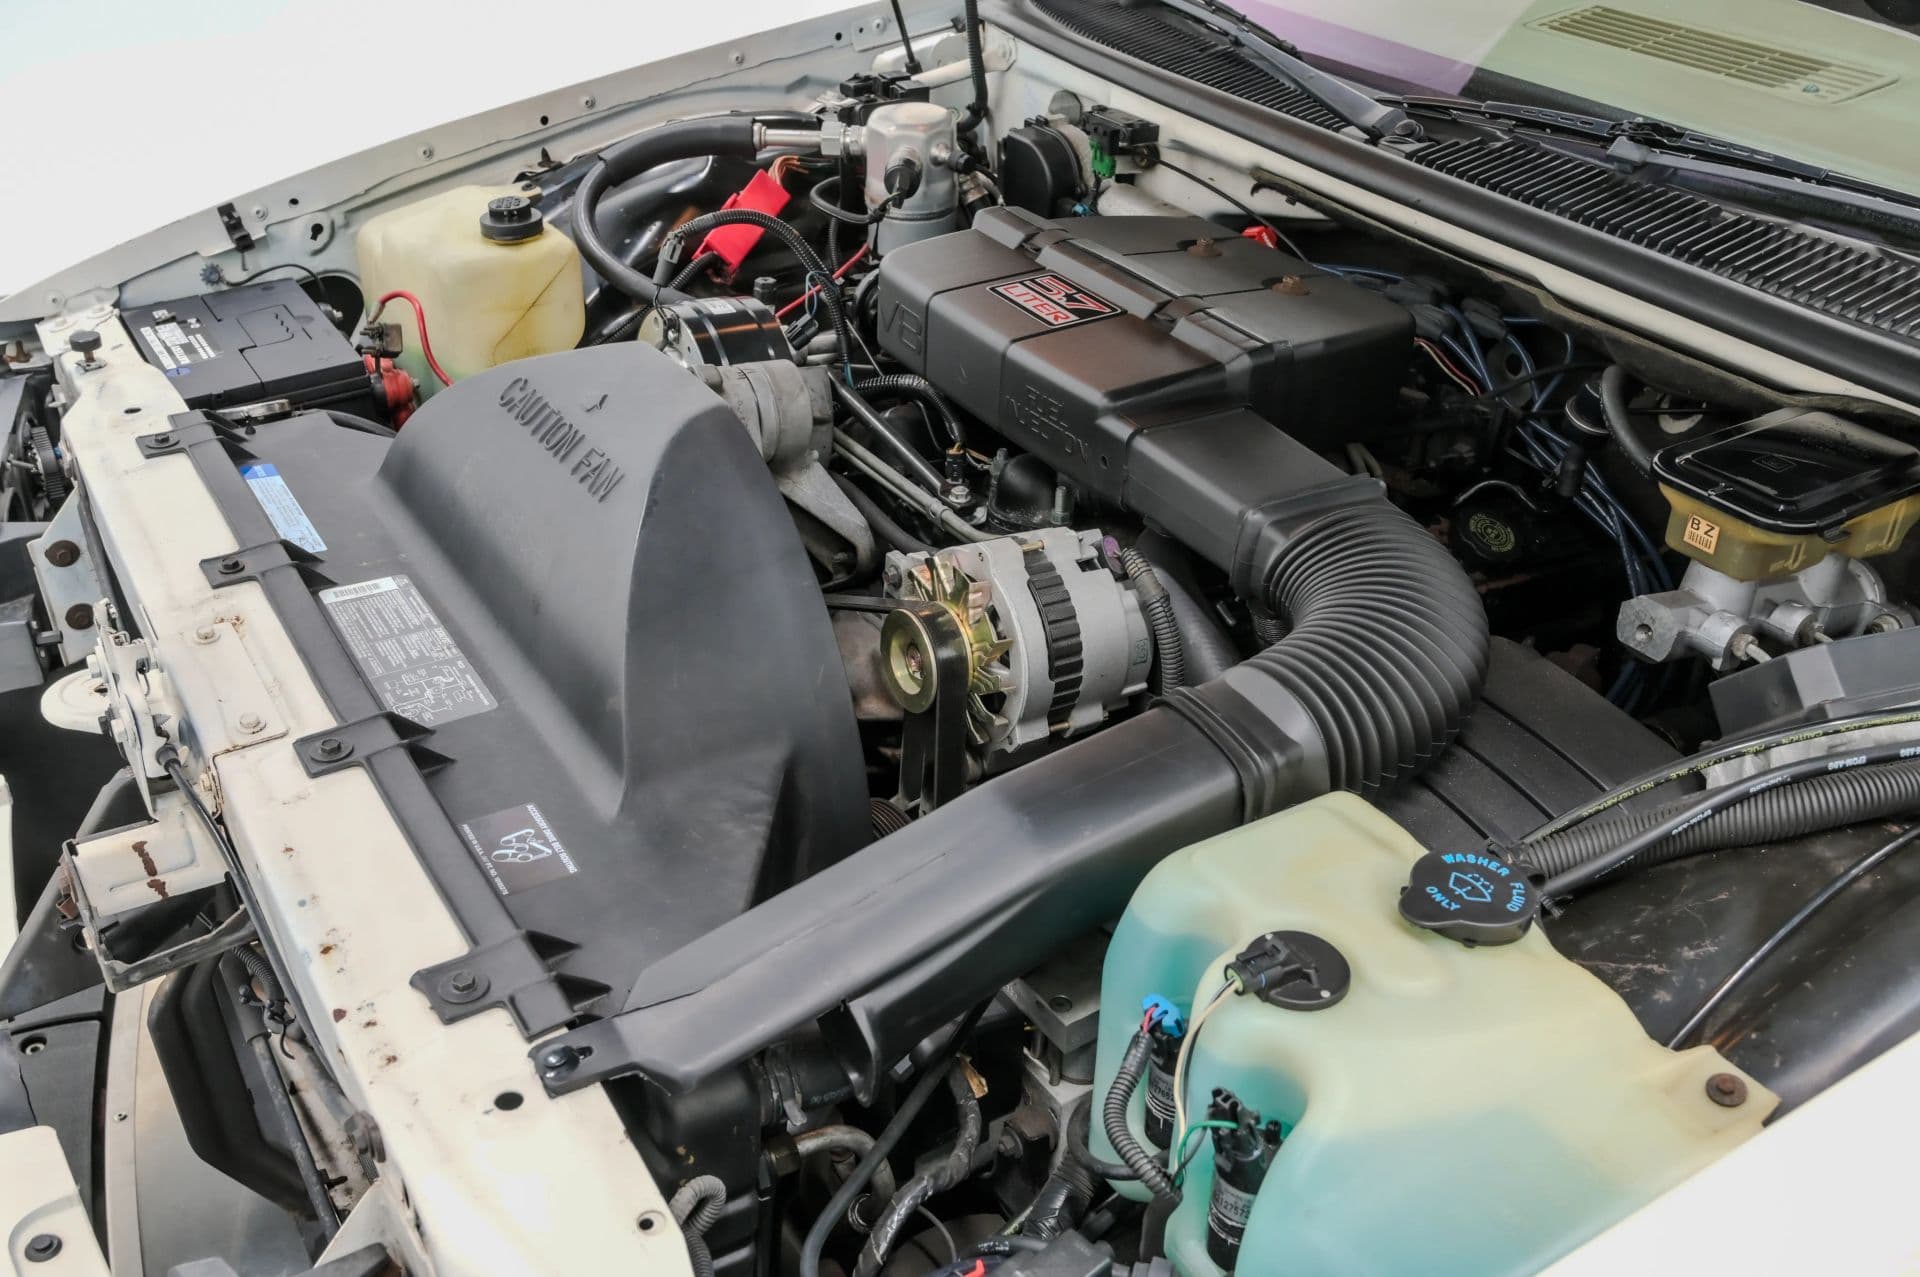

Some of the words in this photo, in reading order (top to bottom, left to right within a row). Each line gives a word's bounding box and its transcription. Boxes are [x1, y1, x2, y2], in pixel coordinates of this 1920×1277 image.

[1002, 284, 1072, 323] LITER
[1021, 275, 1113, 312] 5.7
[498, 376, 587, 465] CAUTION
[570, 447, 626, 504] FAN
[1441, 853, 1511, 877] WASHER
[1425, 885, 1462, 912] ONLY
[1505, 881, 1527, 913] FLUID
